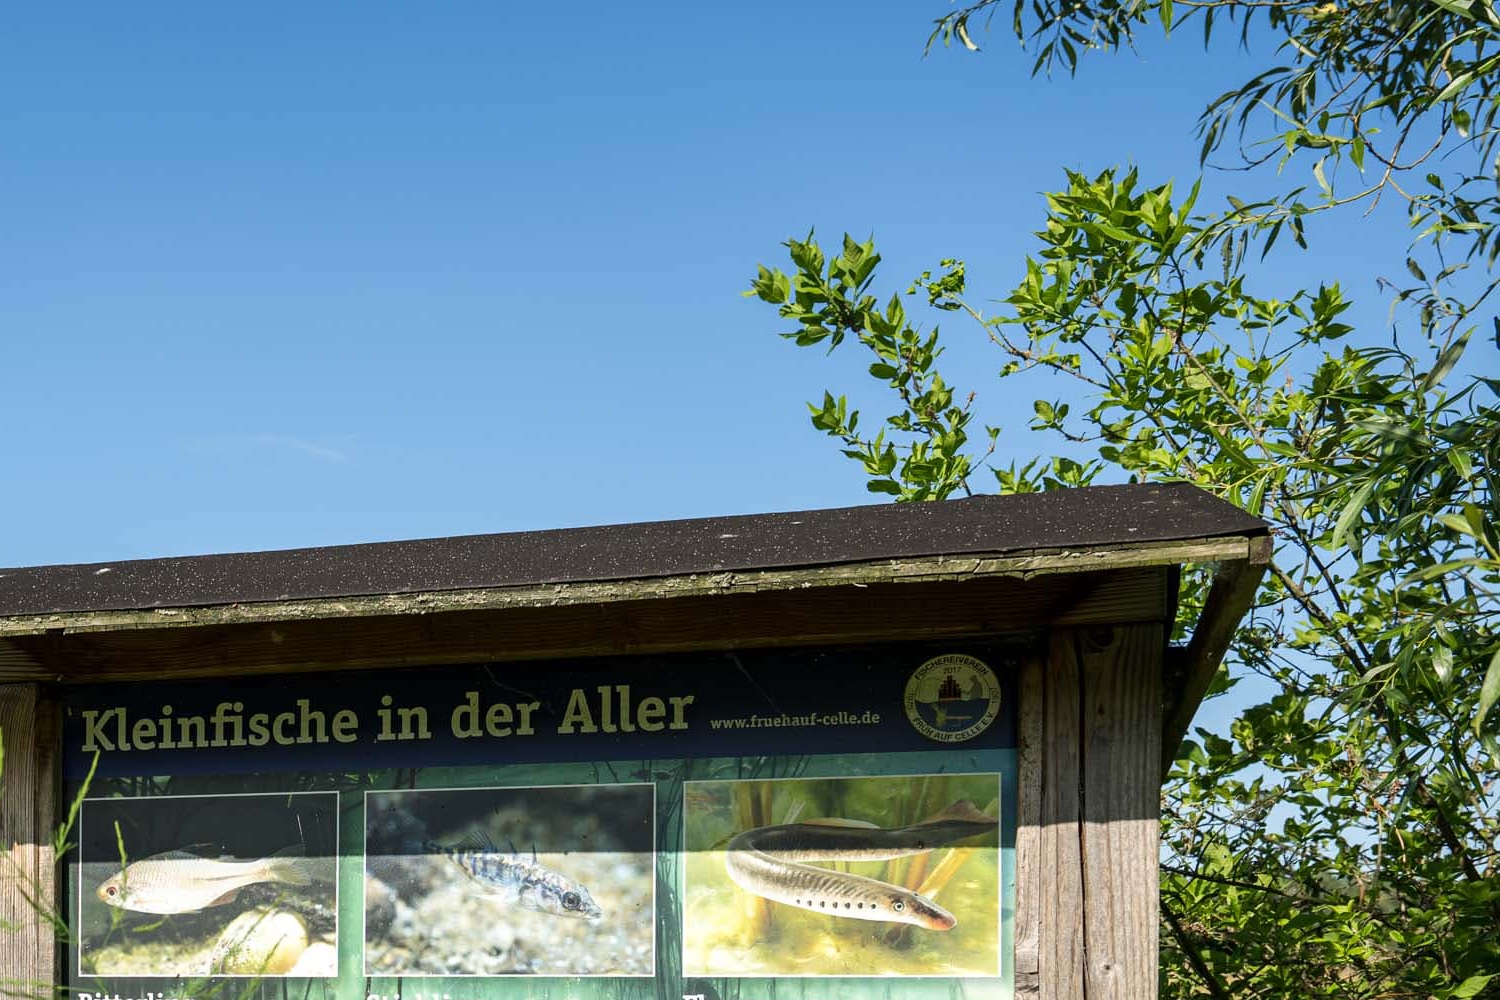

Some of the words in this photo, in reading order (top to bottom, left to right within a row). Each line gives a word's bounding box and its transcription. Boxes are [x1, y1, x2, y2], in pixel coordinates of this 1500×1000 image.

[82, 698, 358, 752] Kleinfische
[377, 695, 432, 740] in
[450, 691, 541, 739] der
[557, 684, 695, 734] Aller
[709, 711, 880, 729] www.fruehauf-celle.de
